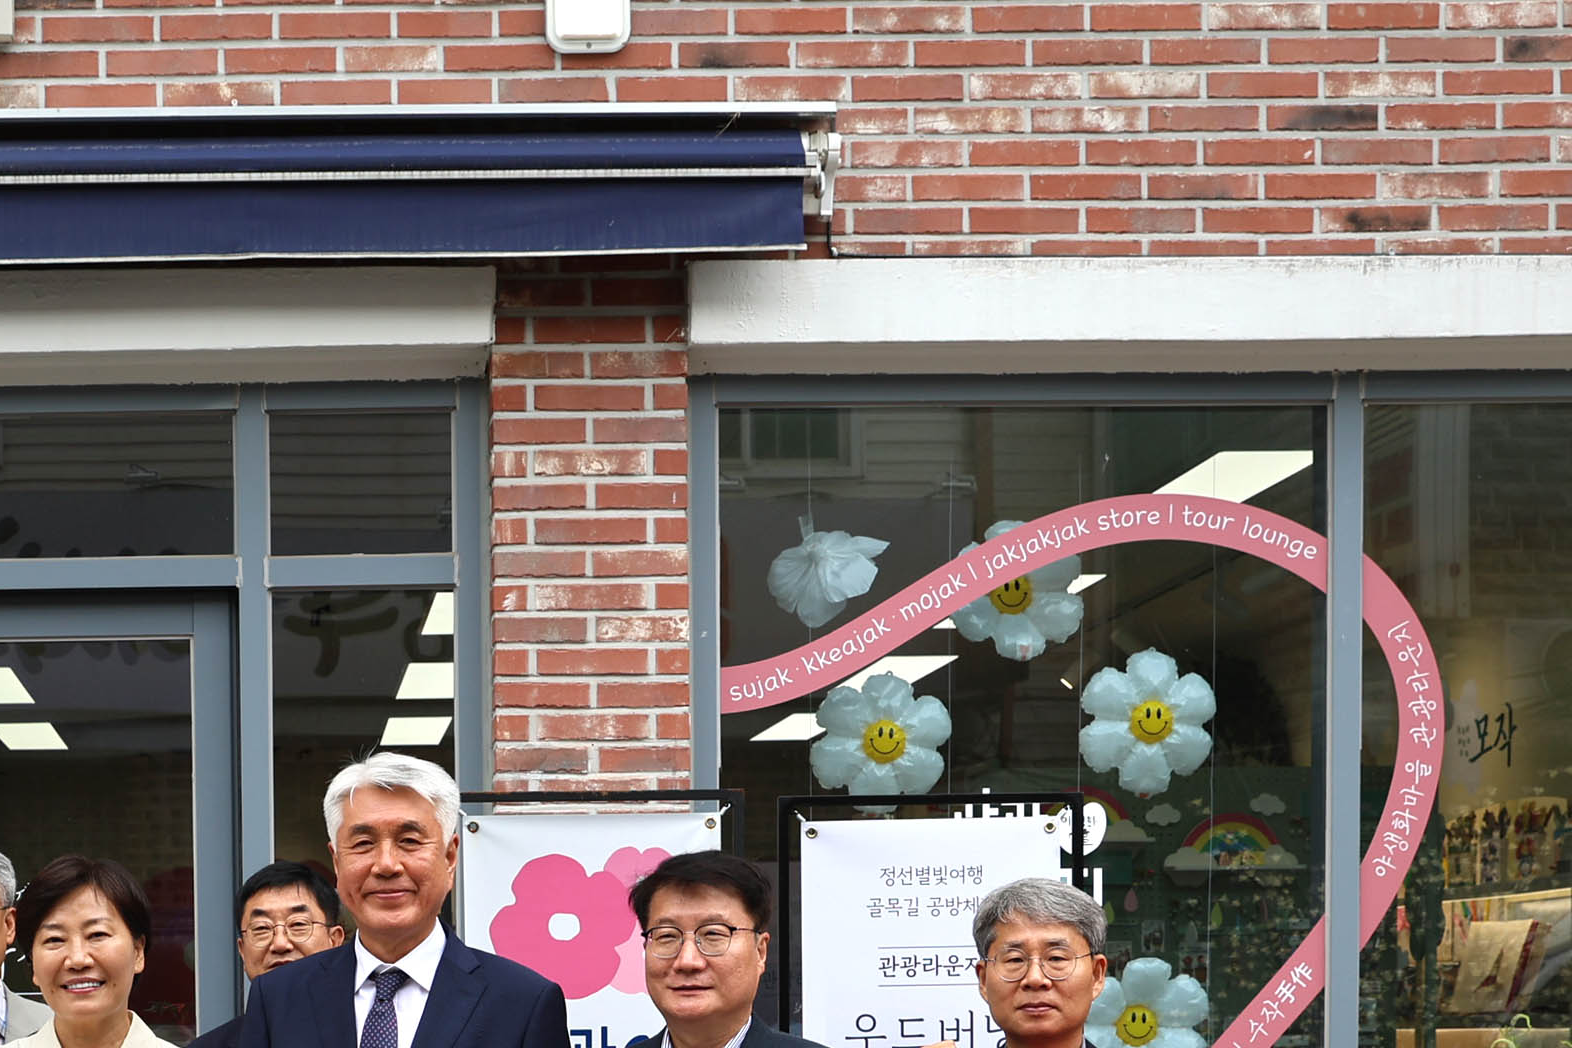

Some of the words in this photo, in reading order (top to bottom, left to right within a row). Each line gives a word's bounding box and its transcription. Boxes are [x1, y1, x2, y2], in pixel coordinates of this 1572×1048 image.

[730, 665, 794, 701] sujak
[801, 617, 892, 676] kkeajak
[899, 571, 967, 622] mojak
[982, 517, 1091, 578] jakjakjak
[1098, 507, 1161, 531] store
[1182, 504, 1236, 531] tour
[1242, 516, 1318, 560] lounge
[1387, 619, 1438, 749] 관광라운지
[879, 864, 984, 888] 정선별빛여행
[1372, 759, 1433, 877] 야생화마을
[866, 896, 920, 918] 골목길
[926, 896, 980, 917] 공방체
